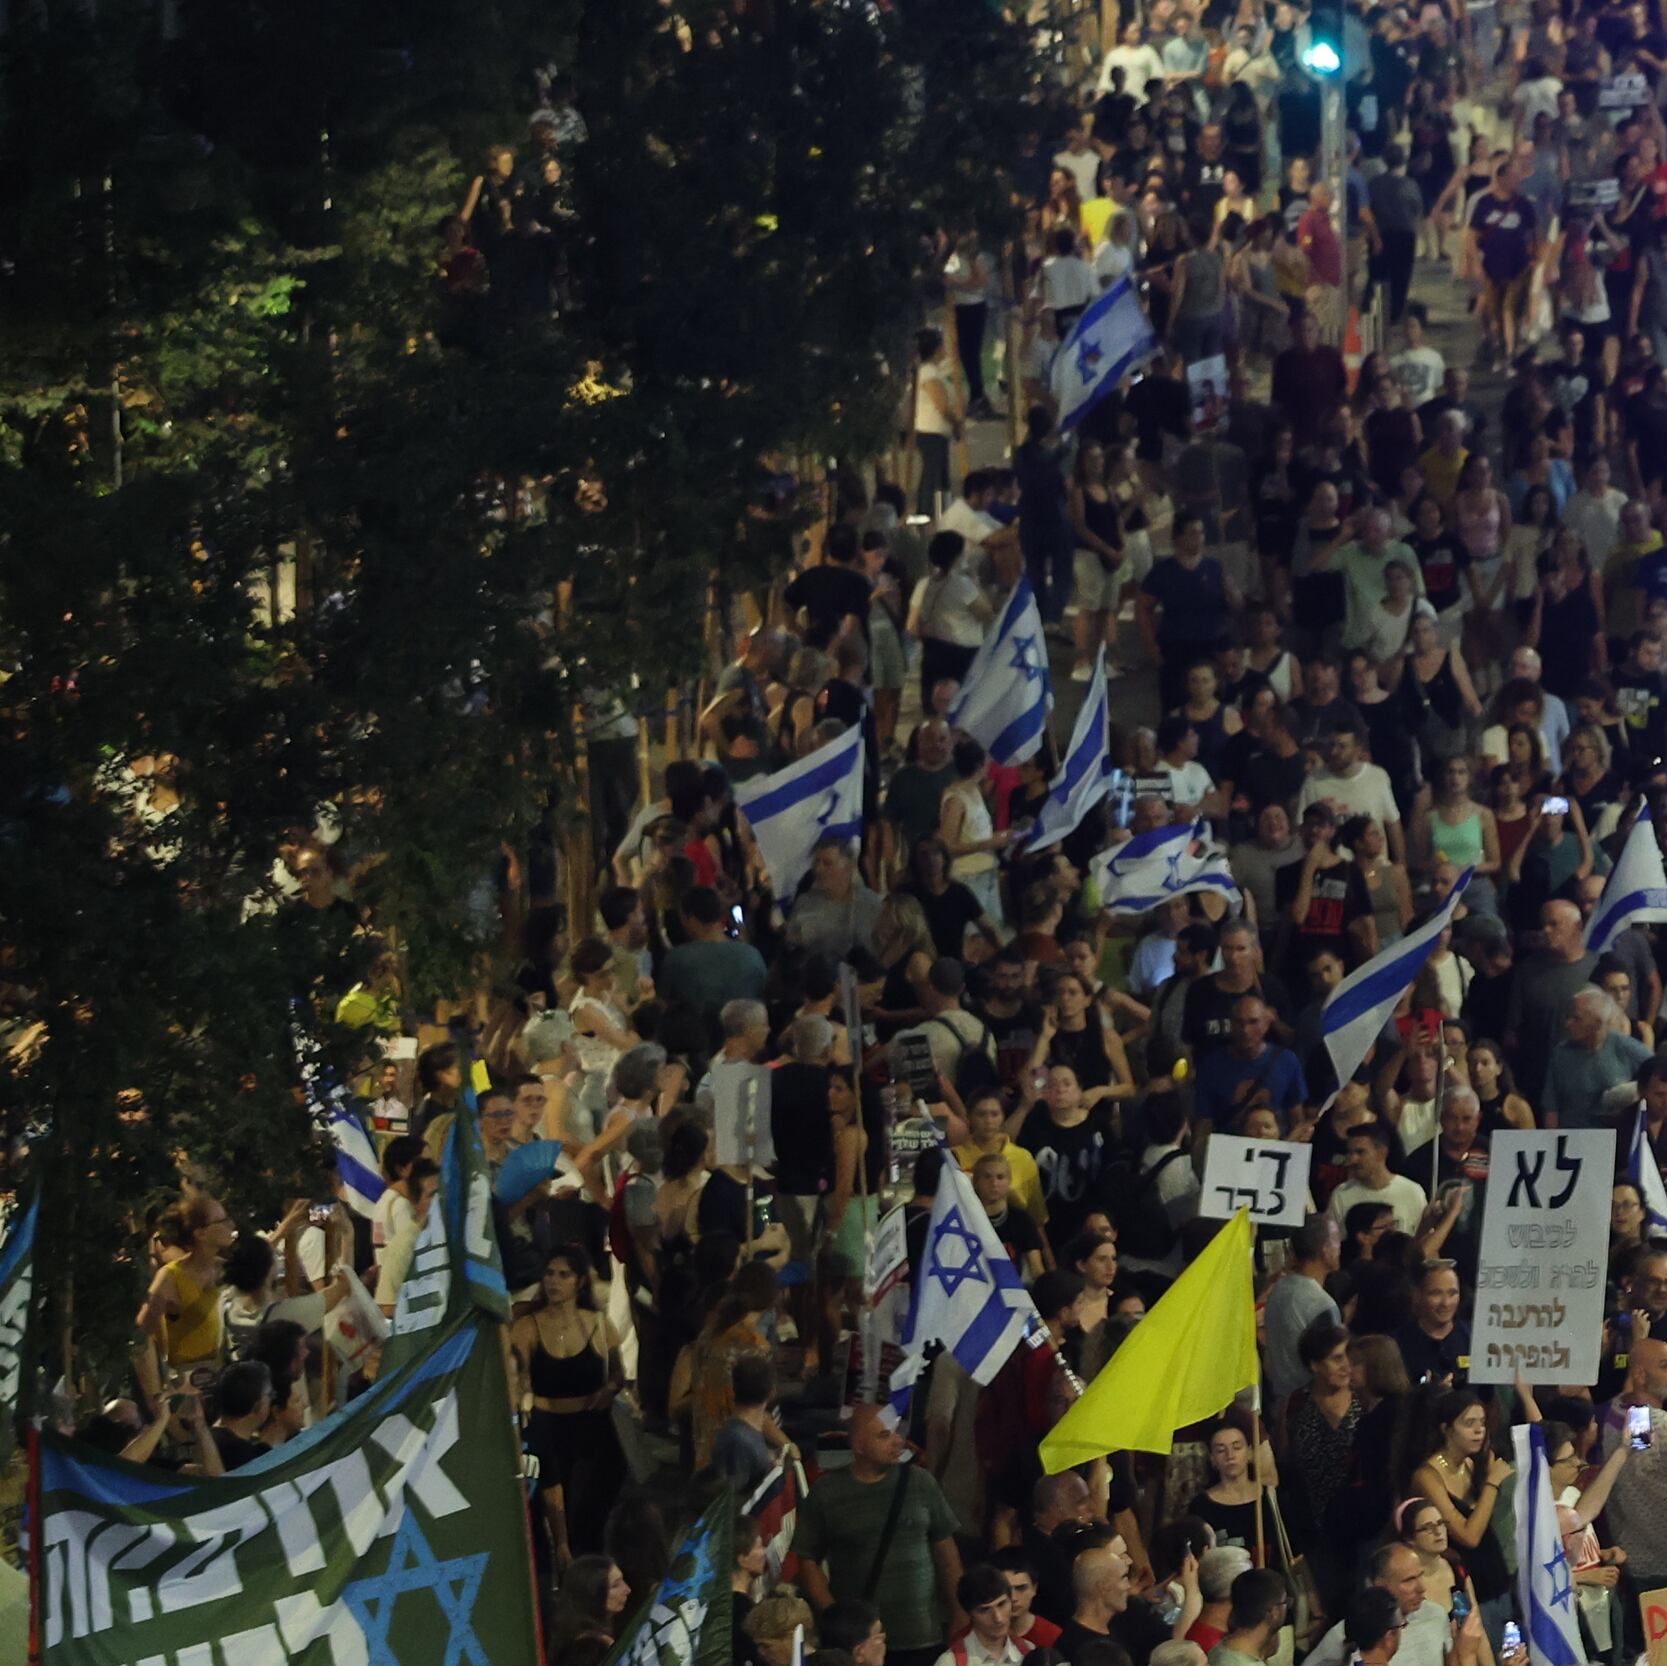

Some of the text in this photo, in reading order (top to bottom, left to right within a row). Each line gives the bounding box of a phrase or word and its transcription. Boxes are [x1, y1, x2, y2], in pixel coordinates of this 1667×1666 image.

[1244, 1147, 1292, 1189] די
[1507, 1137, 1581, 1209] לא
[1216, 1187, 1285, 1216] כבר
[1508, 1219, 1577, 1250] לכיבוש
[1489, 1298, 1566, 1329] להרעבה
